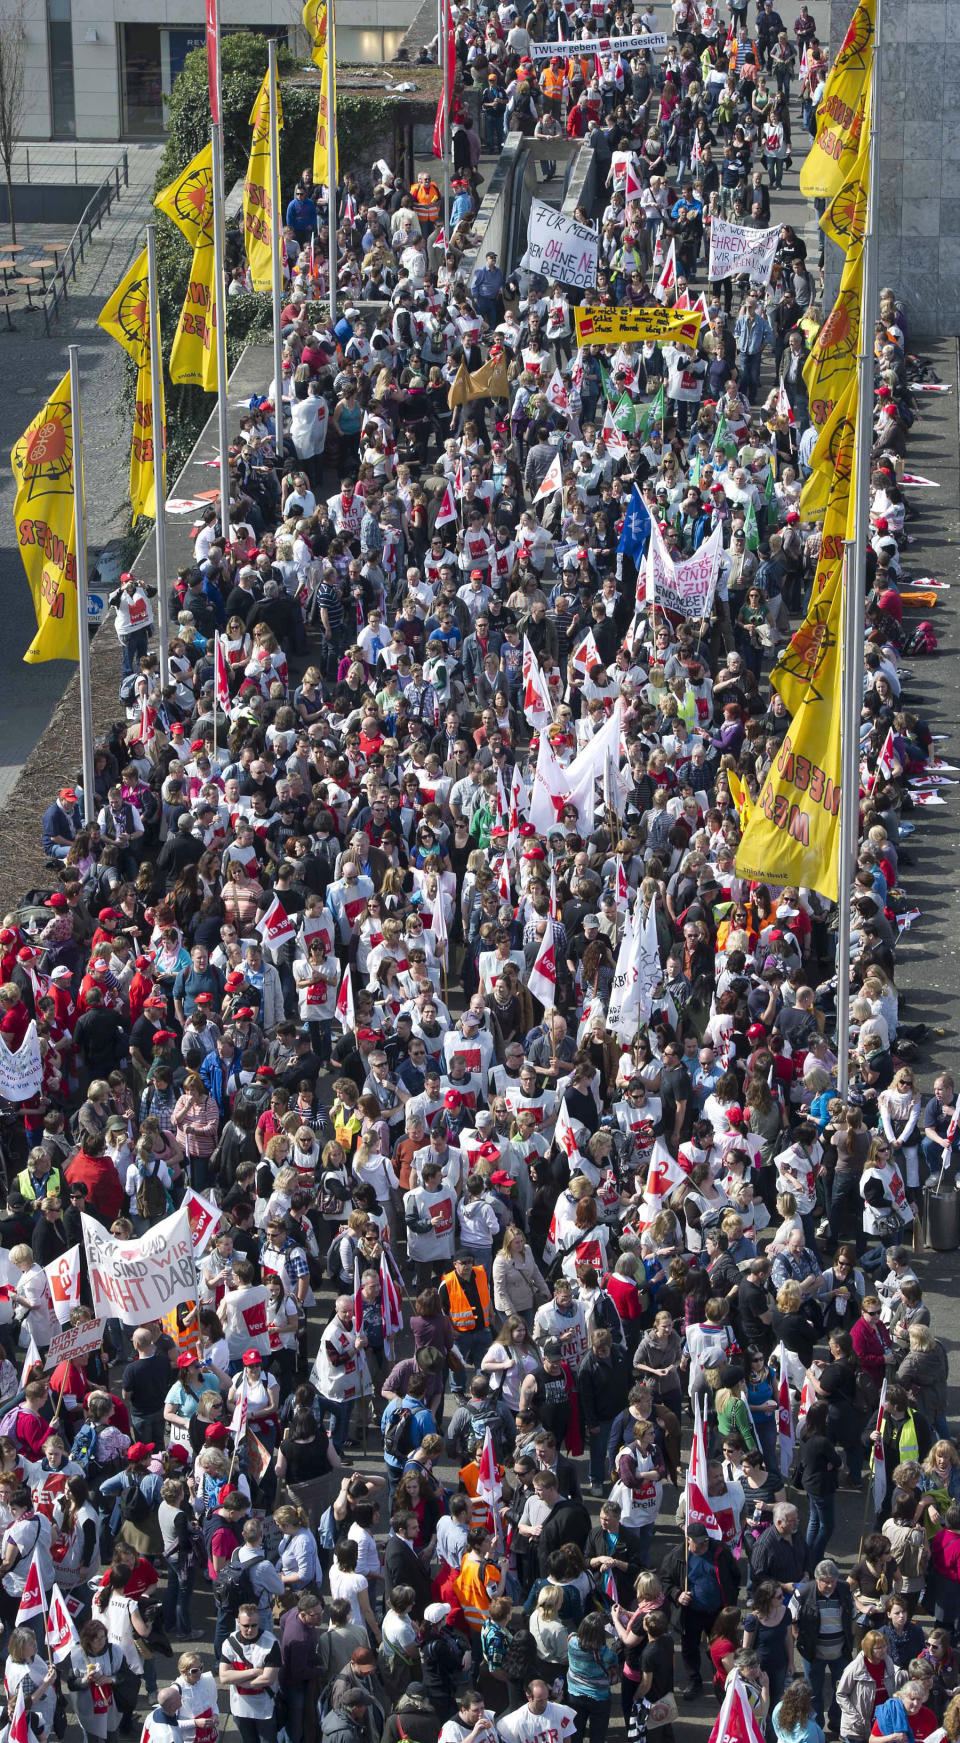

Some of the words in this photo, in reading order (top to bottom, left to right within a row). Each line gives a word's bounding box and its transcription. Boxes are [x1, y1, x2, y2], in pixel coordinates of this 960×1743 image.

[533, 45, 566, 54] TWL-er
[569, 44, 597, 54] geben
[614, 38, 628, 48] ein
[631, 35, 664, 46] Gesicht
[536, 206, 566, 230] FÜR
[545, 239, 578, 270] OHNE
[714, 251, 730, 262] WIR
[113, 1260, 148, 1278] SIND
[151, 1240, 190, 1268] WIR
[52, 1328, 79, 1348] KITA'S
[82, 1318, 100, 1334] DER
[48, 1338, 76, 1358] STADT
[56, 1340, 101, 1364] DIERDORF
[632, 1498, 656, 1510] treik
